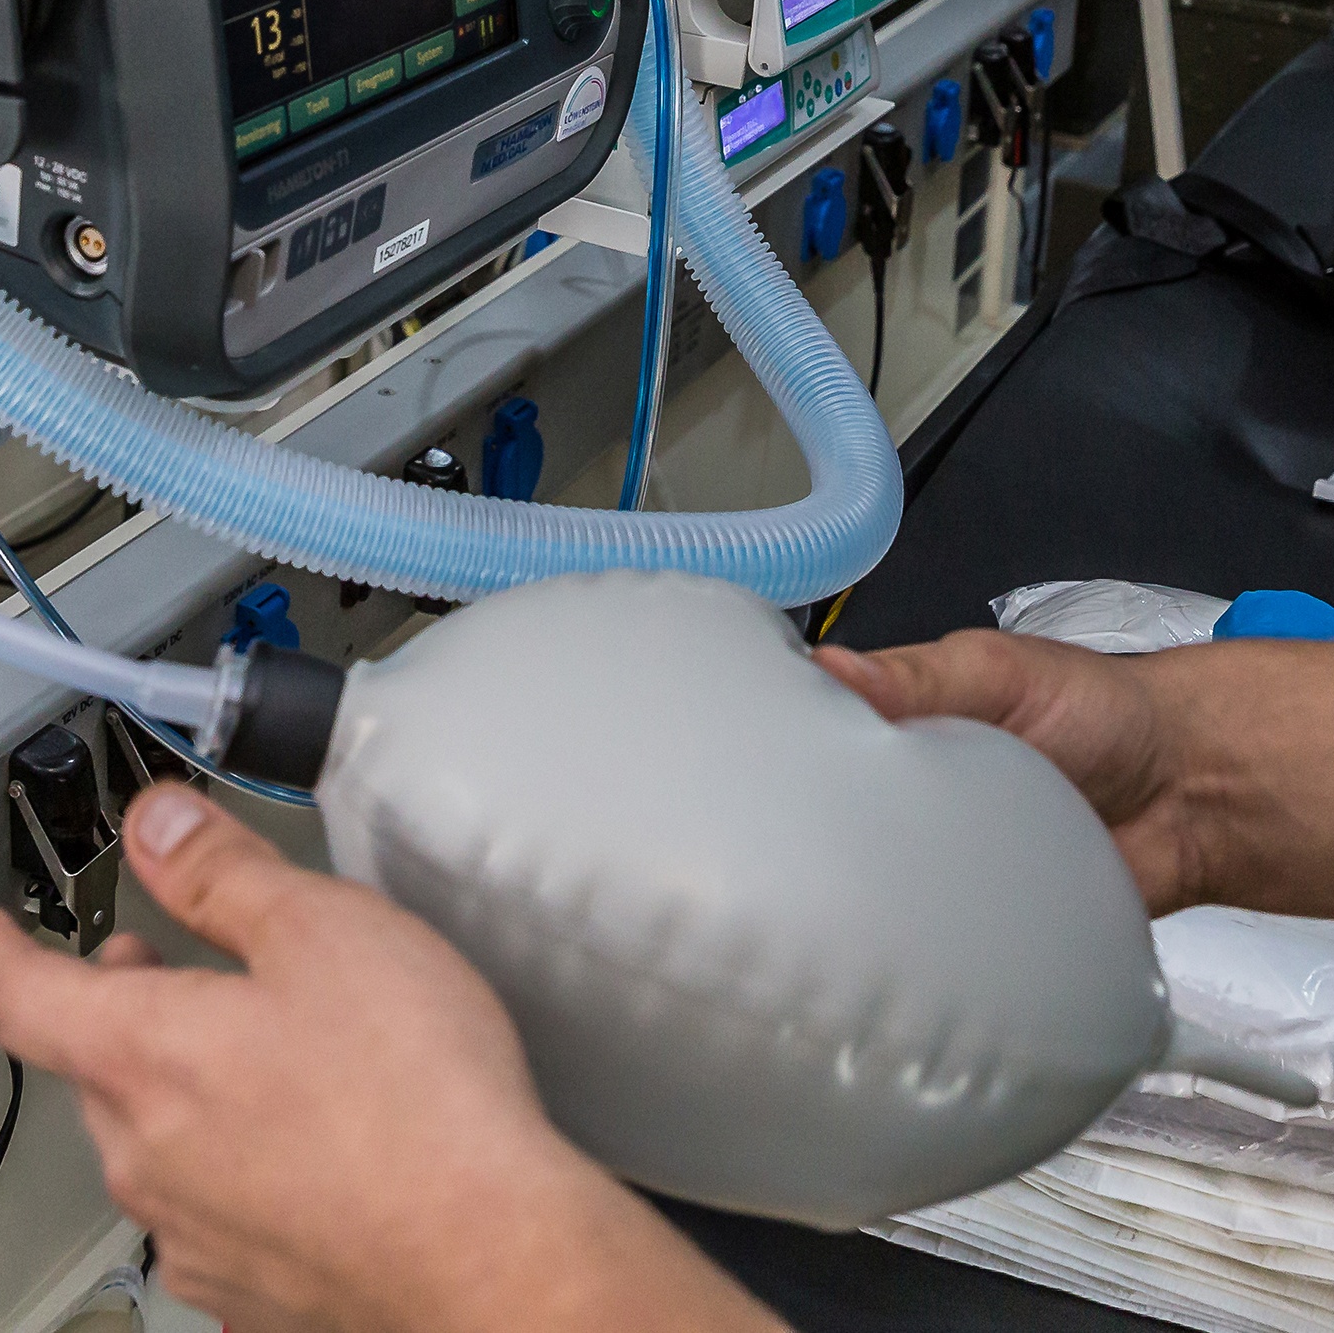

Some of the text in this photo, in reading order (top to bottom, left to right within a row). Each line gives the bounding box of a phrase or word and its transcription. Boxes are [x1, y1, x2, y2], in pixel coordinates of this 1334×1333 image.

[250, 9, 282, 55] 13
[379, 227, 425, 264] 15278217
[169, 630, 183, 647] DC
[79, 695, 94, 712] DC
